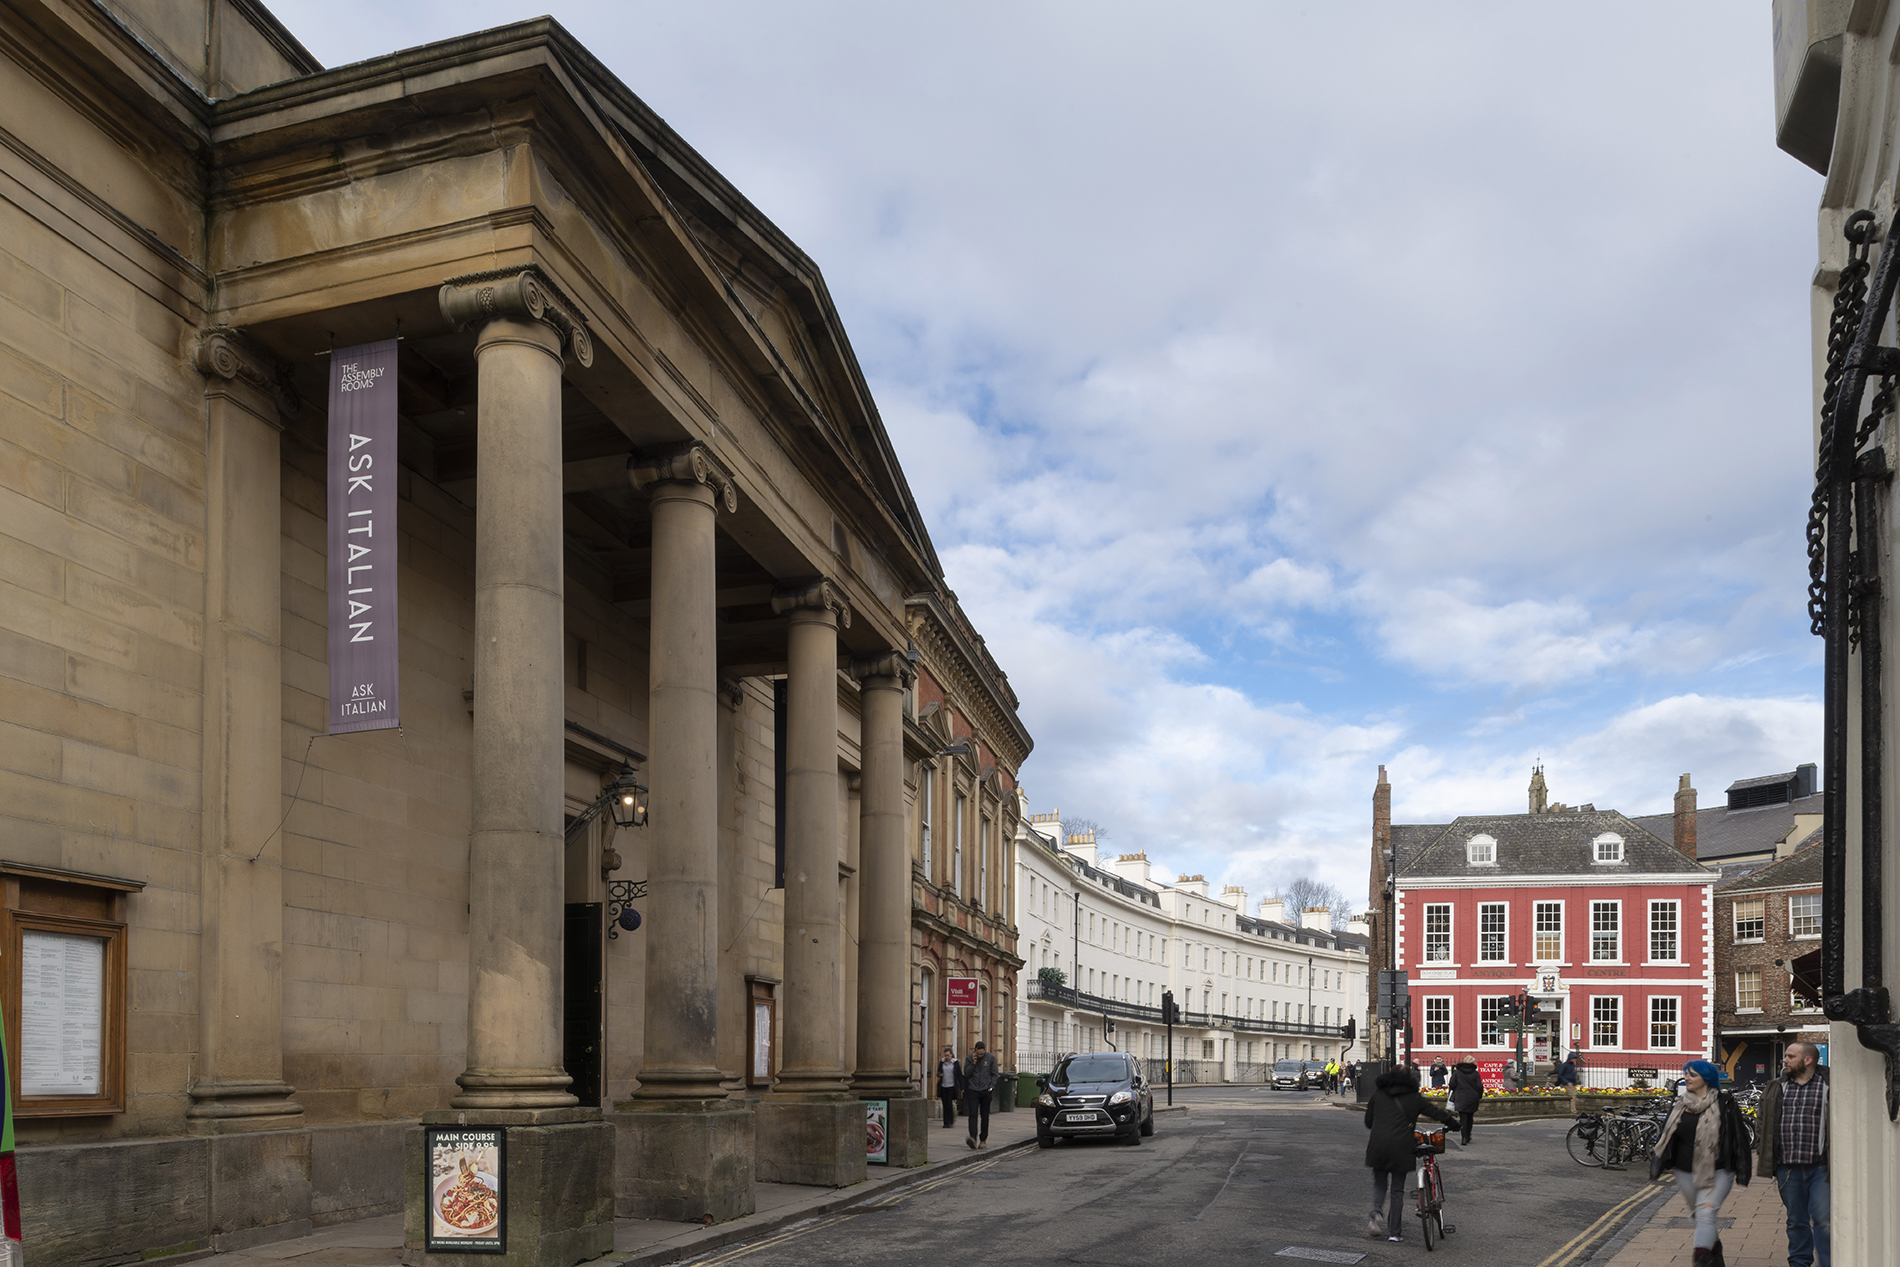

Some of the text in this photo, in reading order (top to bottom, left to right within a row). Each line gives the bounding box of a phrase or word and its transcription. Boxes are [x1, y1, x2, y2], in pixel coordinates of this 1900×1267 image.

[341, 363, 358, 374] THE
[341, 367, 385, 383] ASSEMBLY
[341, 379, 374, 392] ROOMS
[348, 433, 374, 643] ASK ITALIAN
[352, 683, 374, 697] ASK
[341, 699, 386, 716] ITALIAN
[1472, 969, 1626, 978] ANTIQUE CENTRE
[436, 1133, 495, 1141] MAIN COURSE
[437, 1142, 443, 1150] &
[447, 1142, 452, 1150] A
[455, 1142, 474, 1150] SIDE
